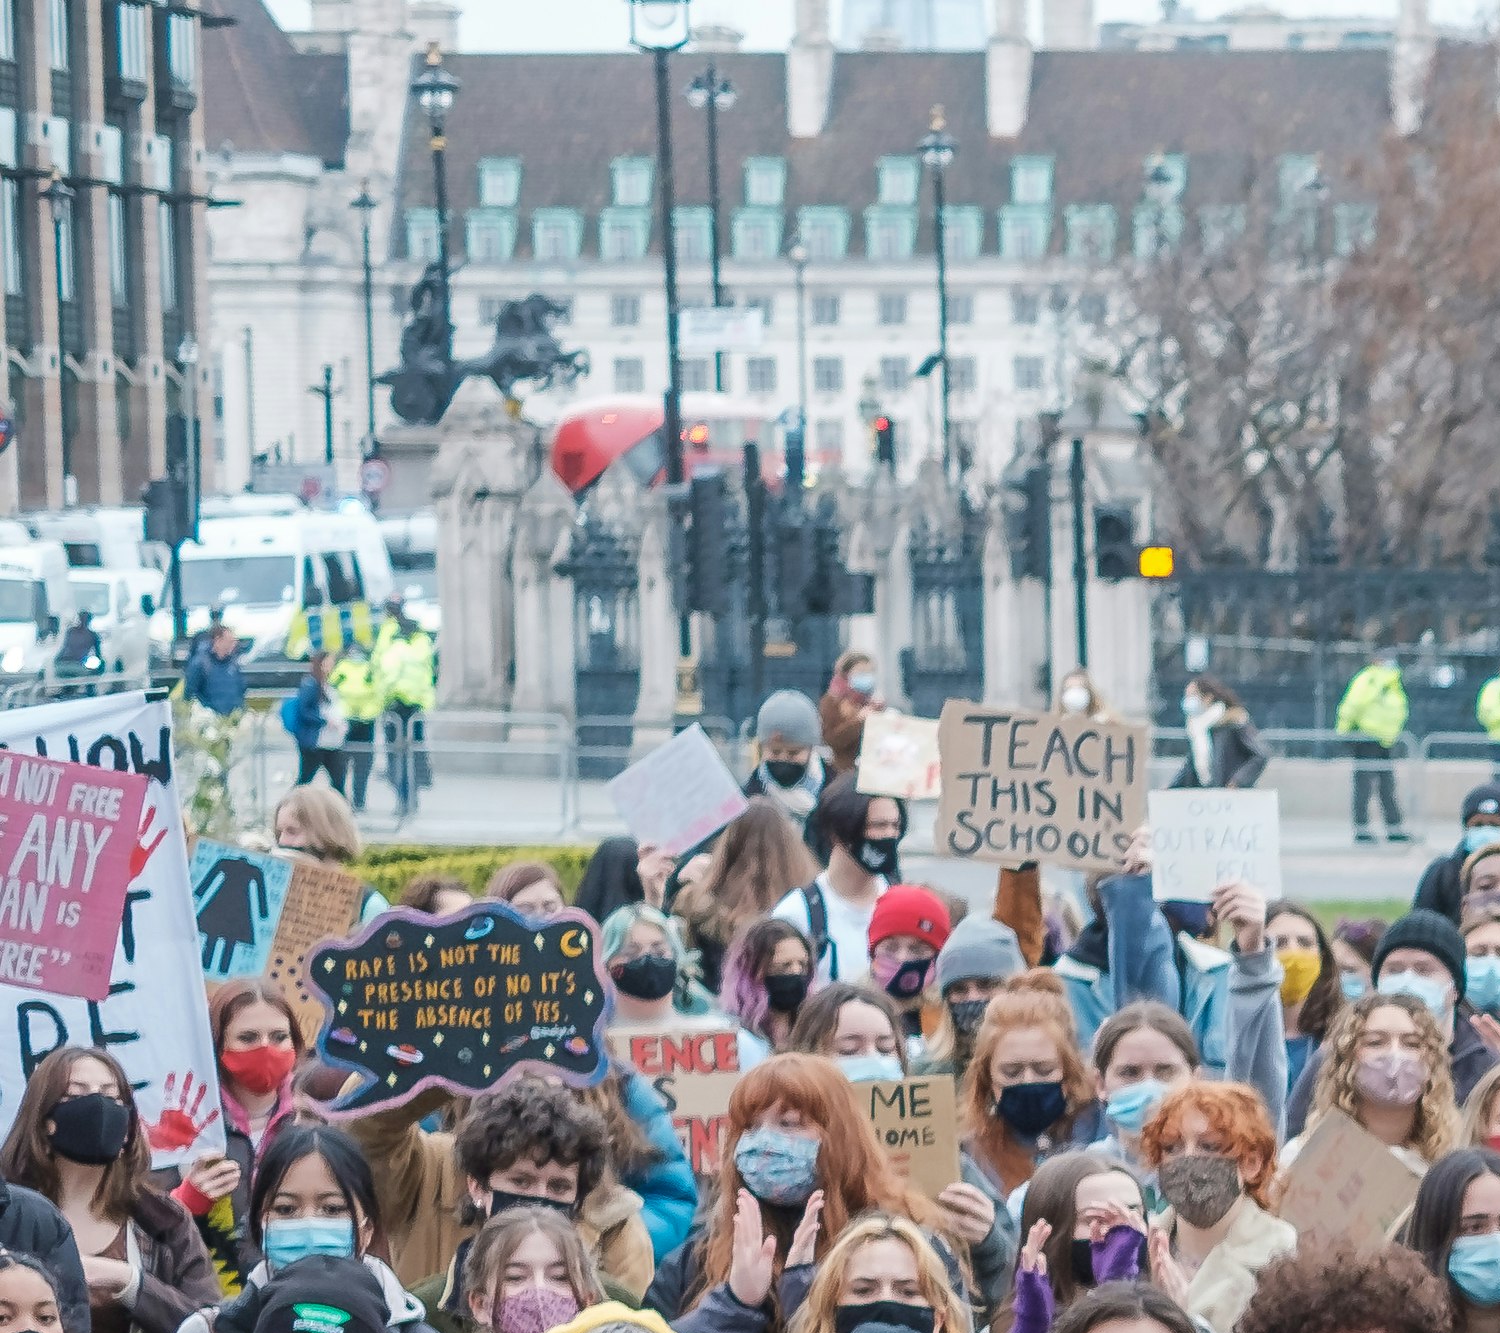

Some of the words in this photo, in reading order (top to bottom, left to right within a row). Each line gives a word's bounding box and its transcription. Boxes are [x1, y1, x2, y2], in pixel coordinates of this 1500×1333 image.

[963, 713, 1136, 785] TEACH
[67, 781, 125, 822] FREE
[957, 772, 1058, 818] THIS
[1077, 786, 1123, 823] IN
[8, 813, 112, 894] ANY
[1152, 824, 1264, 854] OUTRAGE
[56, 900, 82, 929] IS
[344, 954, 395, 981] RAPE
[408, 950, 428, 973] IS
[440, 943, 479, 969] NOT
[487, 942, 522, 966] THE
[364, 979, 463, 1005] PRESENCE
[473, 974, 497, 998] OF
[505, 973, 532, 997] NO
[357, 1008, 399, 1032] THE
[415, 1004, 493, 1030] ABSENCE
[503, 999, 523, 1025] OF
[870, 1082, 934, 1122] ME
